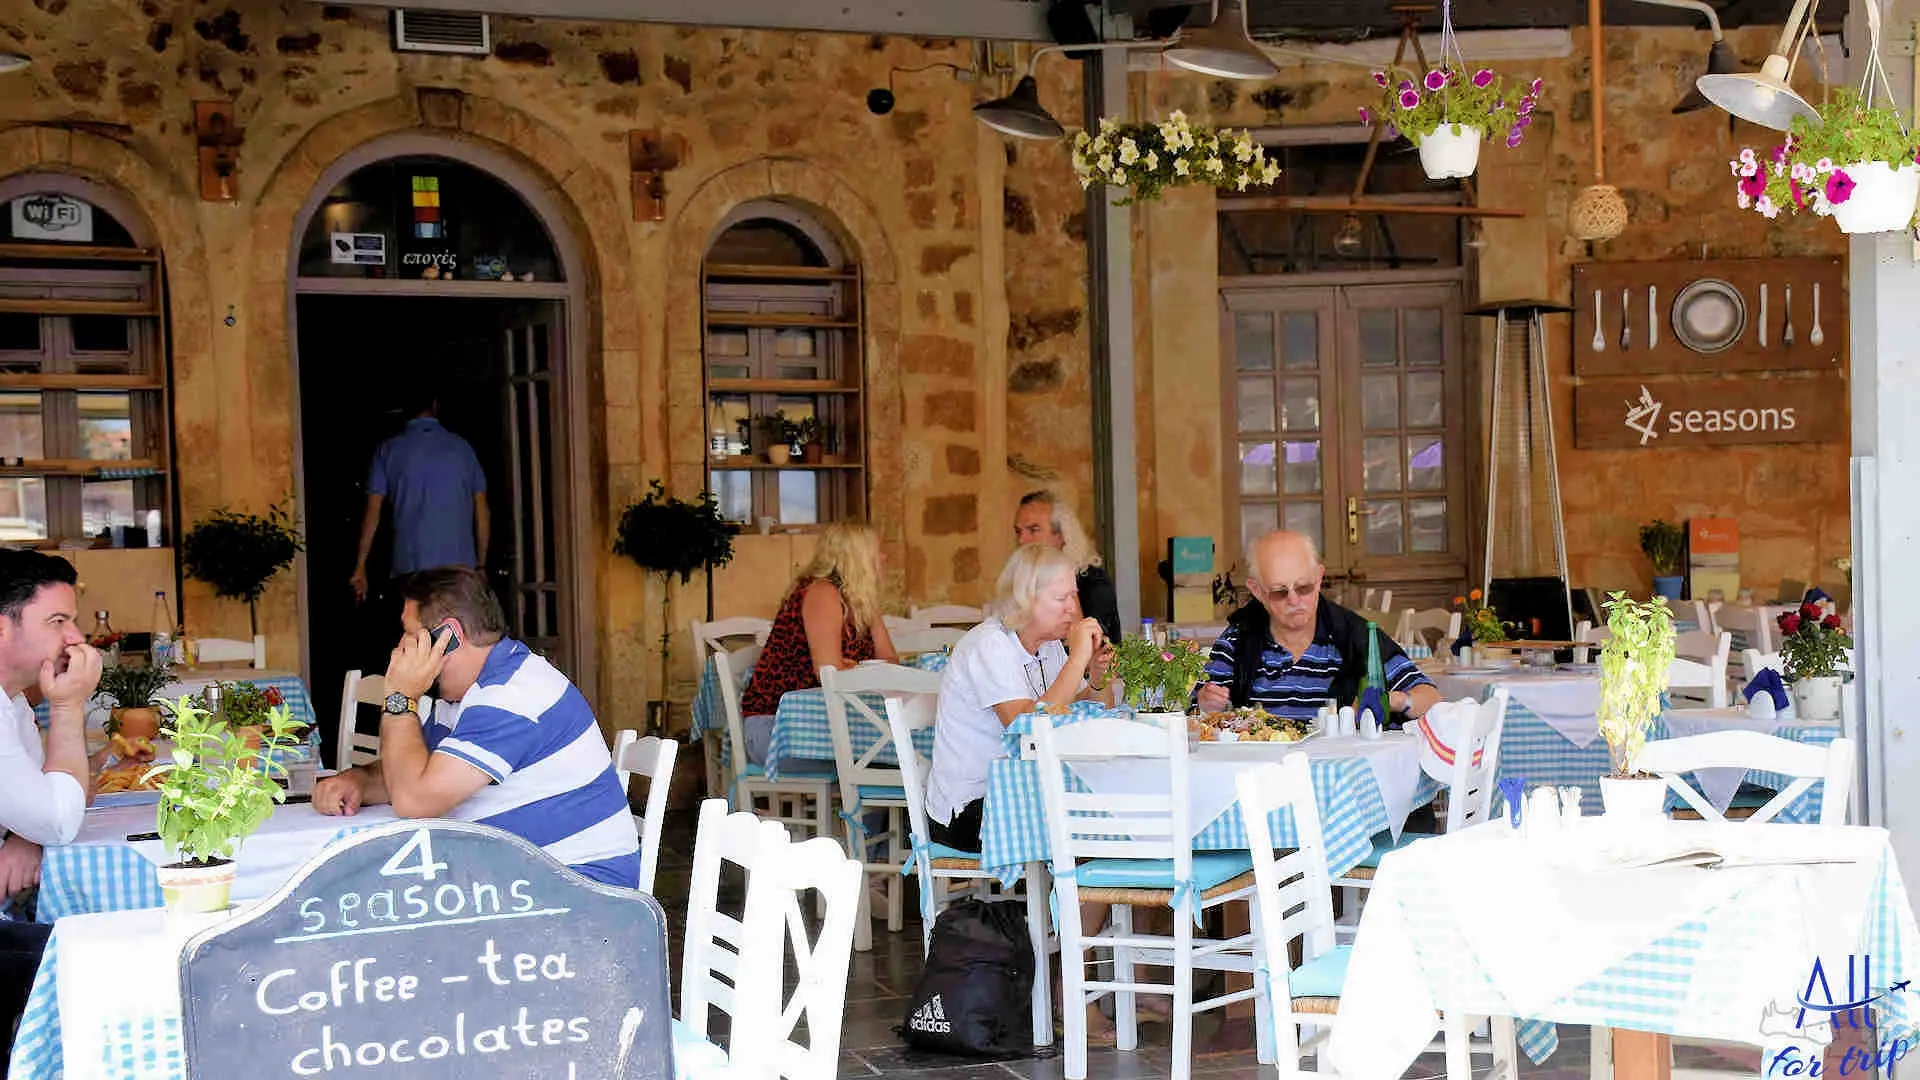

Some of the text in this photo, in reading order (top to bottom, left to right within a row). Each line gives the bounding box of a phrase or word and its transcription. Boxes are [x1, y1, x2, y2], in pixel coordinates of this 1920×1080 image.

[1668, 407, 1796, 433] seasons
[379, 827, 448, 880] 4
[299, 879, 535, 932] seasons
[256, 957, 419, 1015] Coffee
[477, 939, 576, 985] tea
[291, 1006, 590, 1075] chocolates
[910, 1017, 951, 1033] adidas
